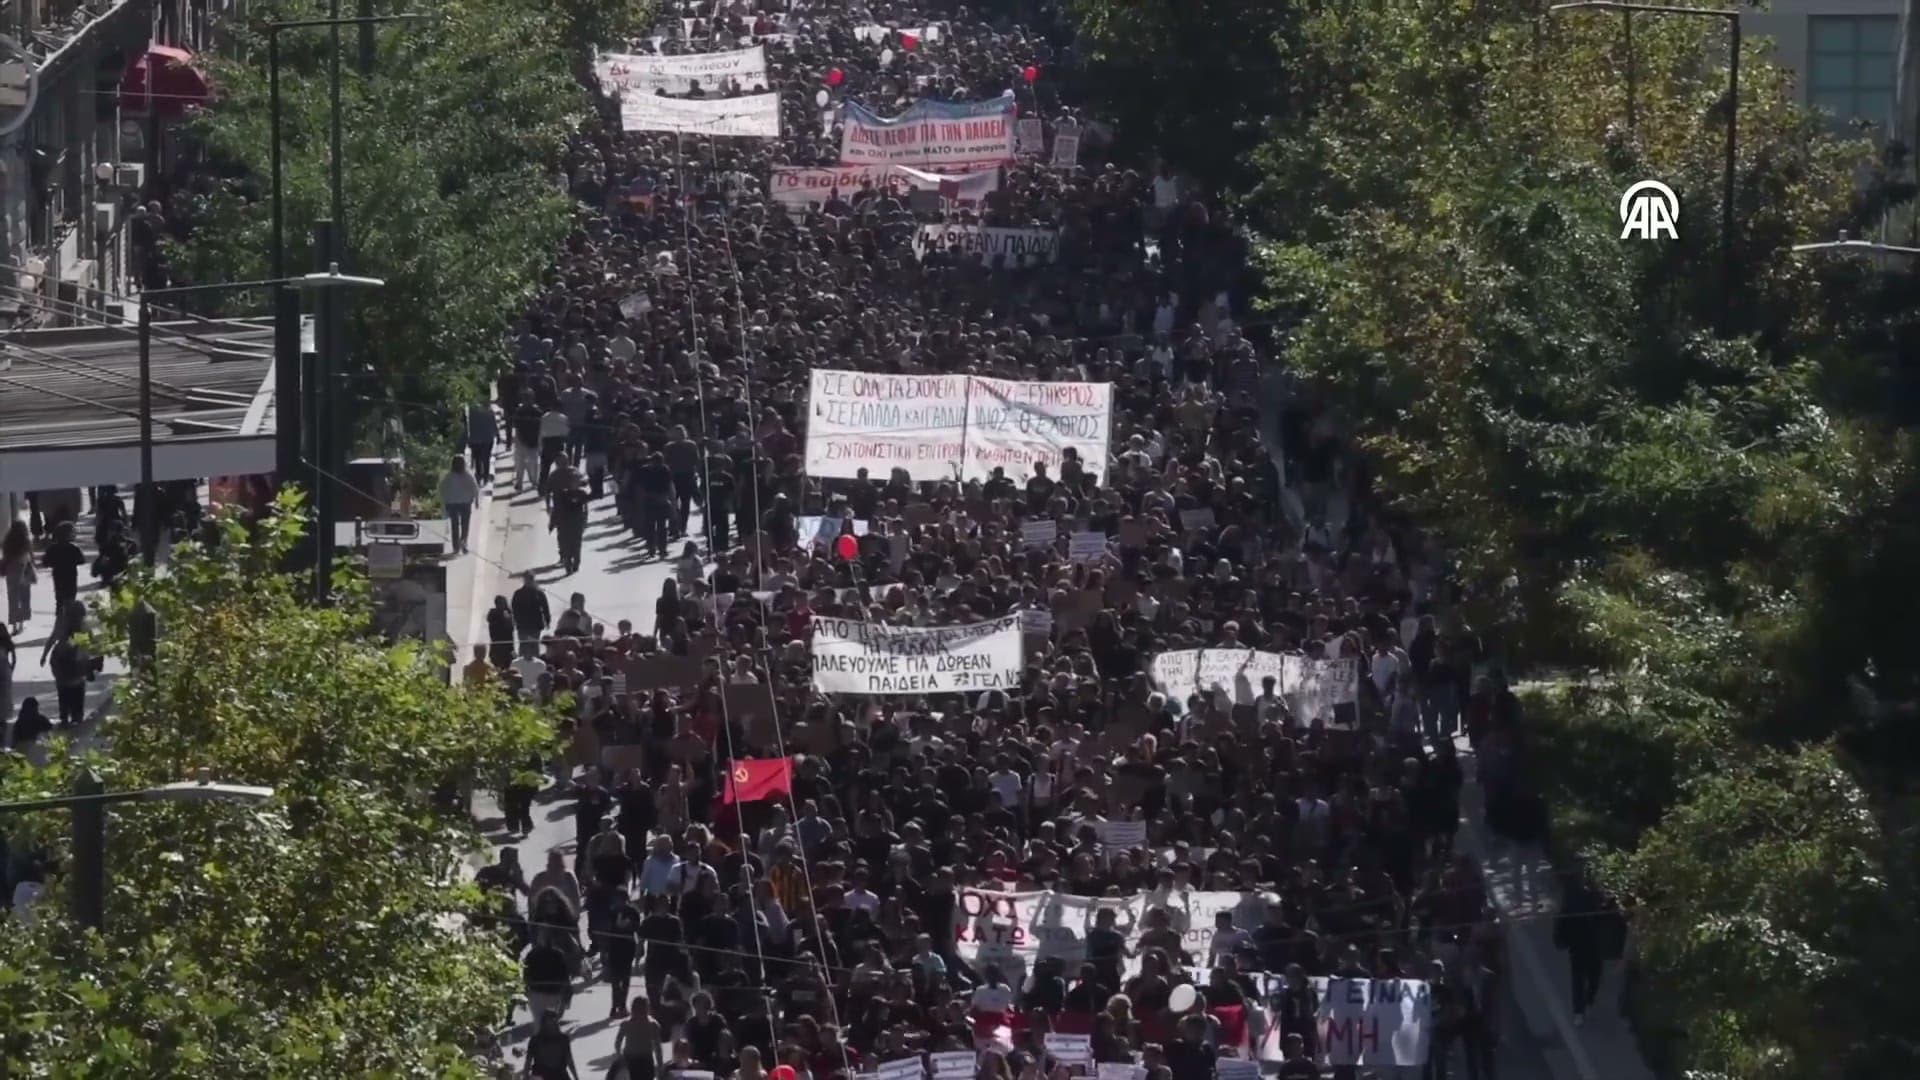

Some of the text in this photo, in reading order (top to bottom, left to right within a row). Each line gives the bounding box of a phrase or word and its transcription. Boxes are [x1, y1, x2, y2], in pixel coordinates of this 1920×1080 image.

[920, 123, 937, 143] ΓΙΑ
[941, 121, 962, 141] ΤΗΝ
[966, 119, 1006, 140] ΠΑΙΔΕΙΑ
[923, 145, 951, 155] ΝΑΤΟ
[823, 372, 849, 396] ΣΕ
[813, 618, 850, 639] ΑΠΟ
[812, 653, 992, 674] ΠΑΛΕΥΟΥΜΕ ΓΙΑ ΔΩΡΕΑΝ
[868, 675, 939, 691] ΠΑΙΔΕΙΑ
[954, 926, 1025, 945] ΚΑΤΩ
